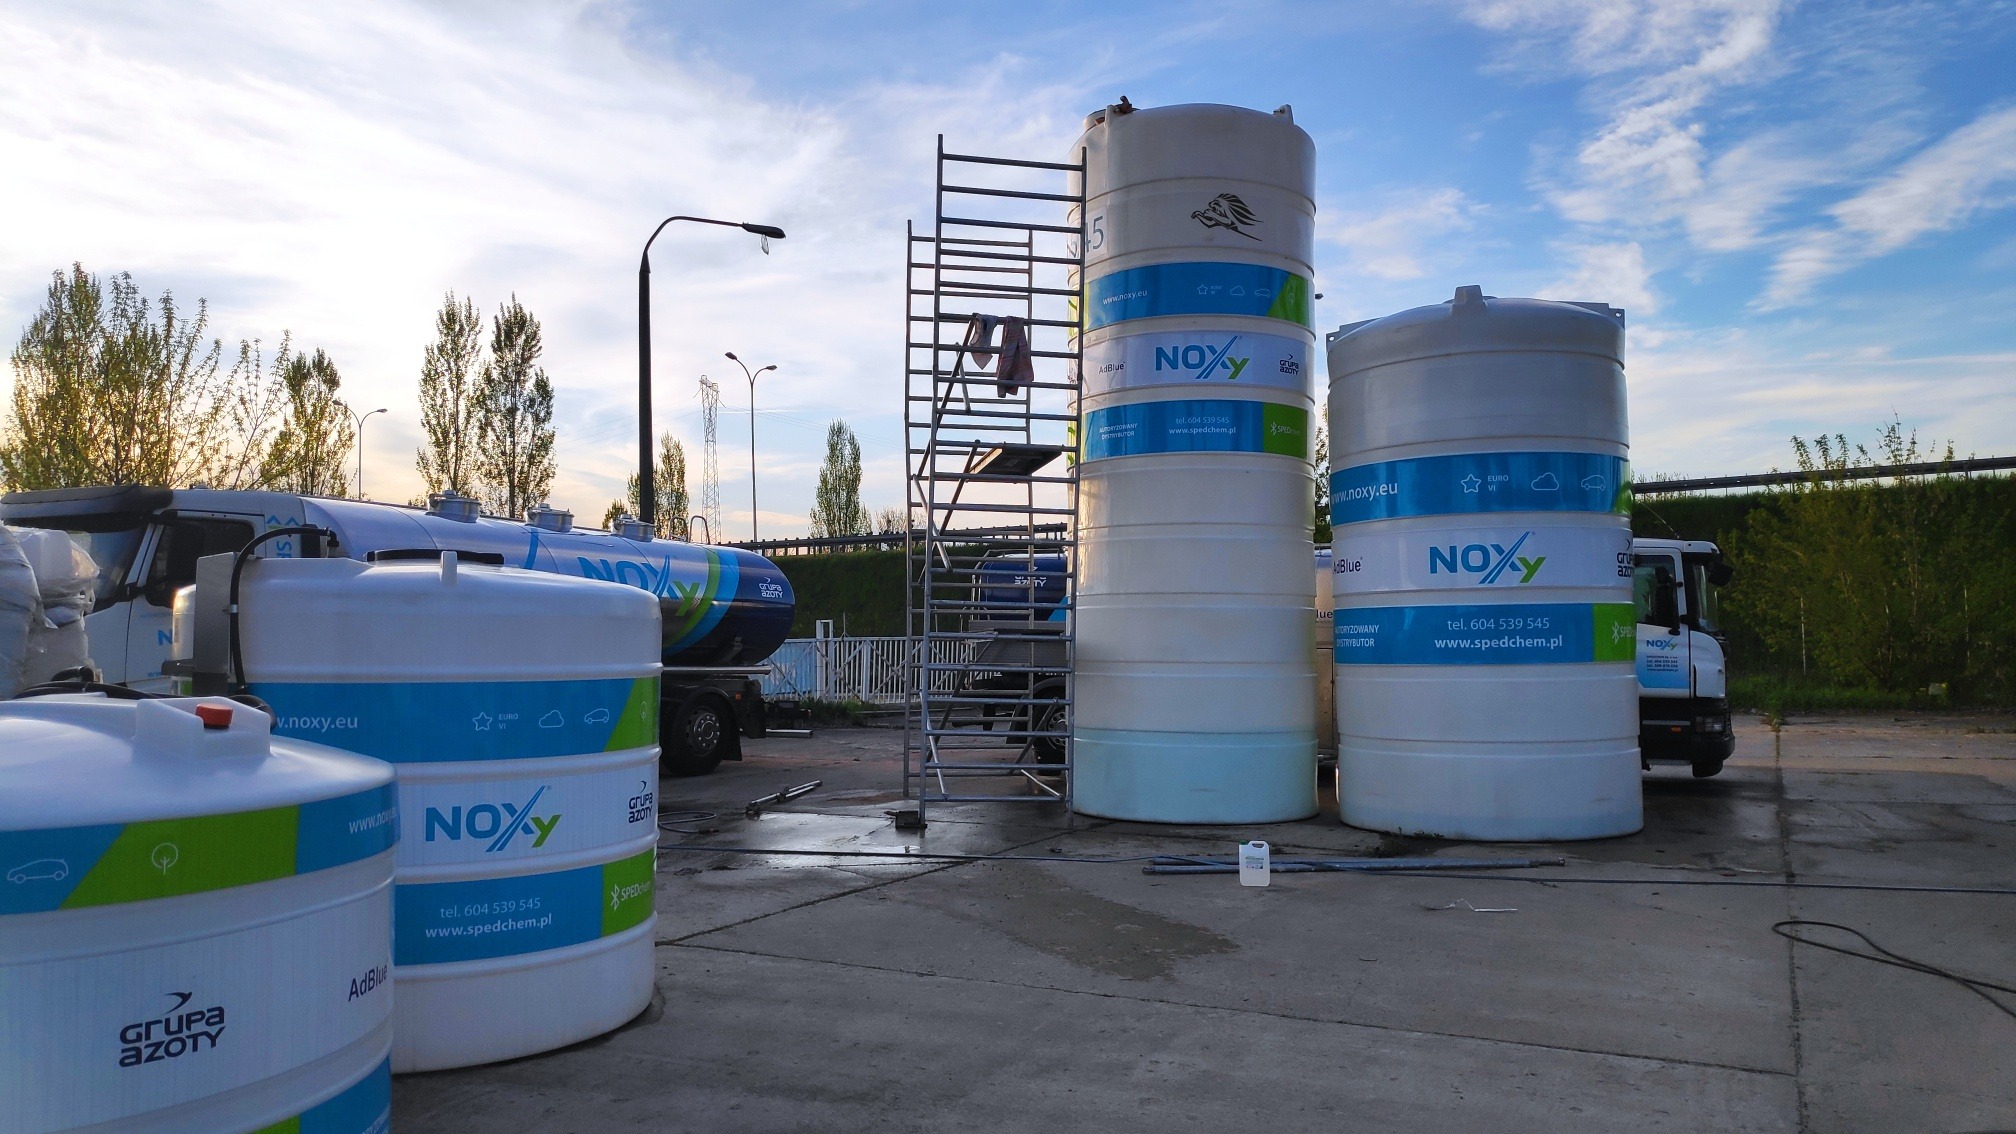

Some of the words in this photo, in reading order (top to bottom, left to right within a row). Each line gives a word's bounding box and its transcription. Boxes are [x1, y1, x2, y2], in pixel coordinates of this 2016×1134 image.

[1099, 360, 1125, 375] AdBlue
[1187, 416, 1201, 424] 604
[1202, 416, 1216, 424] 539
[1216, 416, 1230, 424] 545
[1168, 426, 1236, 435] www.spedchem.pl
[1487, 474, 1509, 482] EURO
[1487, 484, 1496, 492] VI
[1446, 618, 1467, 631] tel.
[1470, 618, 1495, 630] 604
[1499, 618, 1523, 630] 539
[1526, 617, 1550, 629] 545
[1434, 634, 1563, 651] www.spedchem.pl
[498, 713, 519, 721] EURO
[498, 722, 507, 730] VI
[440, 905, 461, 919] tel.
[464, 903, 489, 917] 604
[492, 900, 516, 914] 539
[519, 897, 541, 911] 545
[425, 912, 553, 938] www.spedchem.pl
[348, 964, 389, 1002] AdBlue
